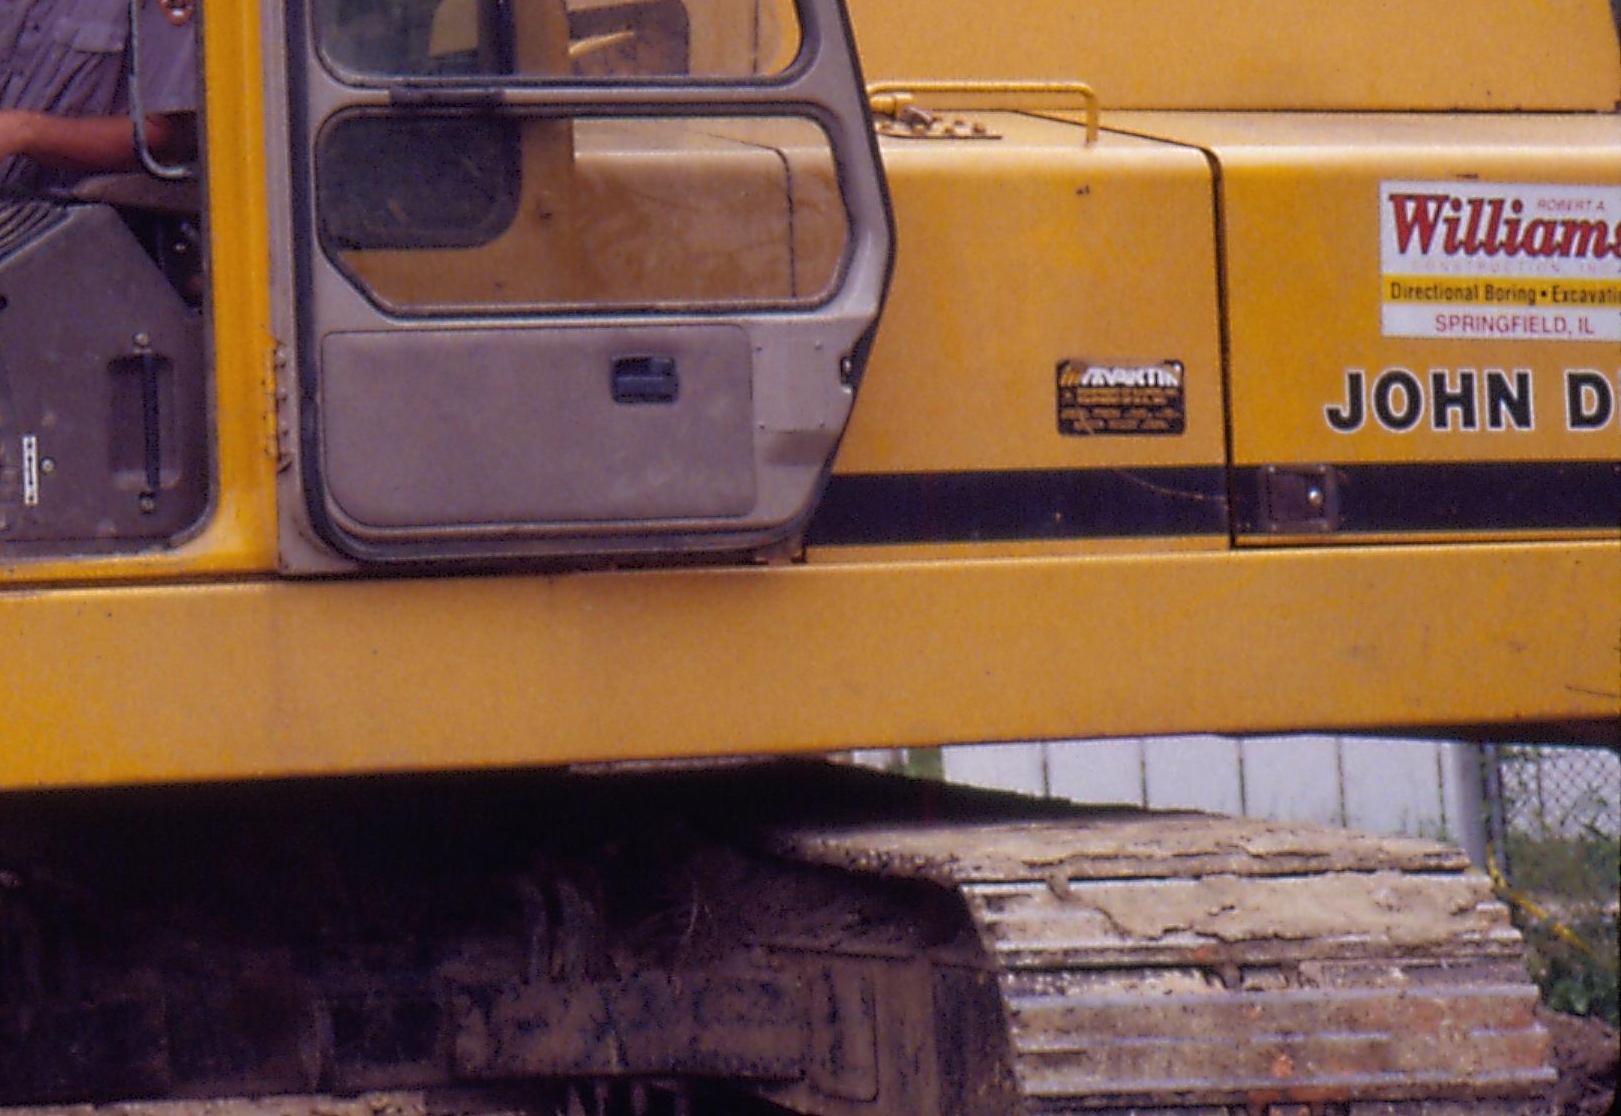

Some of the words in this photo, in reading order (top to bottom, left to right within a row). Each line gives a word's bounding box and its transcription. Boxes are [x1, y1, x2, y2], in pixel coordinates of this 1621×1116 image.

[1391, 282, 1479, 301] Directional
[1485, 284, 1536, 305] Boring
[1552, 285, 1621, 303] Excavati
[1435, 314, 1572, 335] SPRINGFIELD,
[1579, 316, 1595, 334] IL
[1323, 367, 1535, 433] JOHN
[1563, 368, 1621, 433] D
